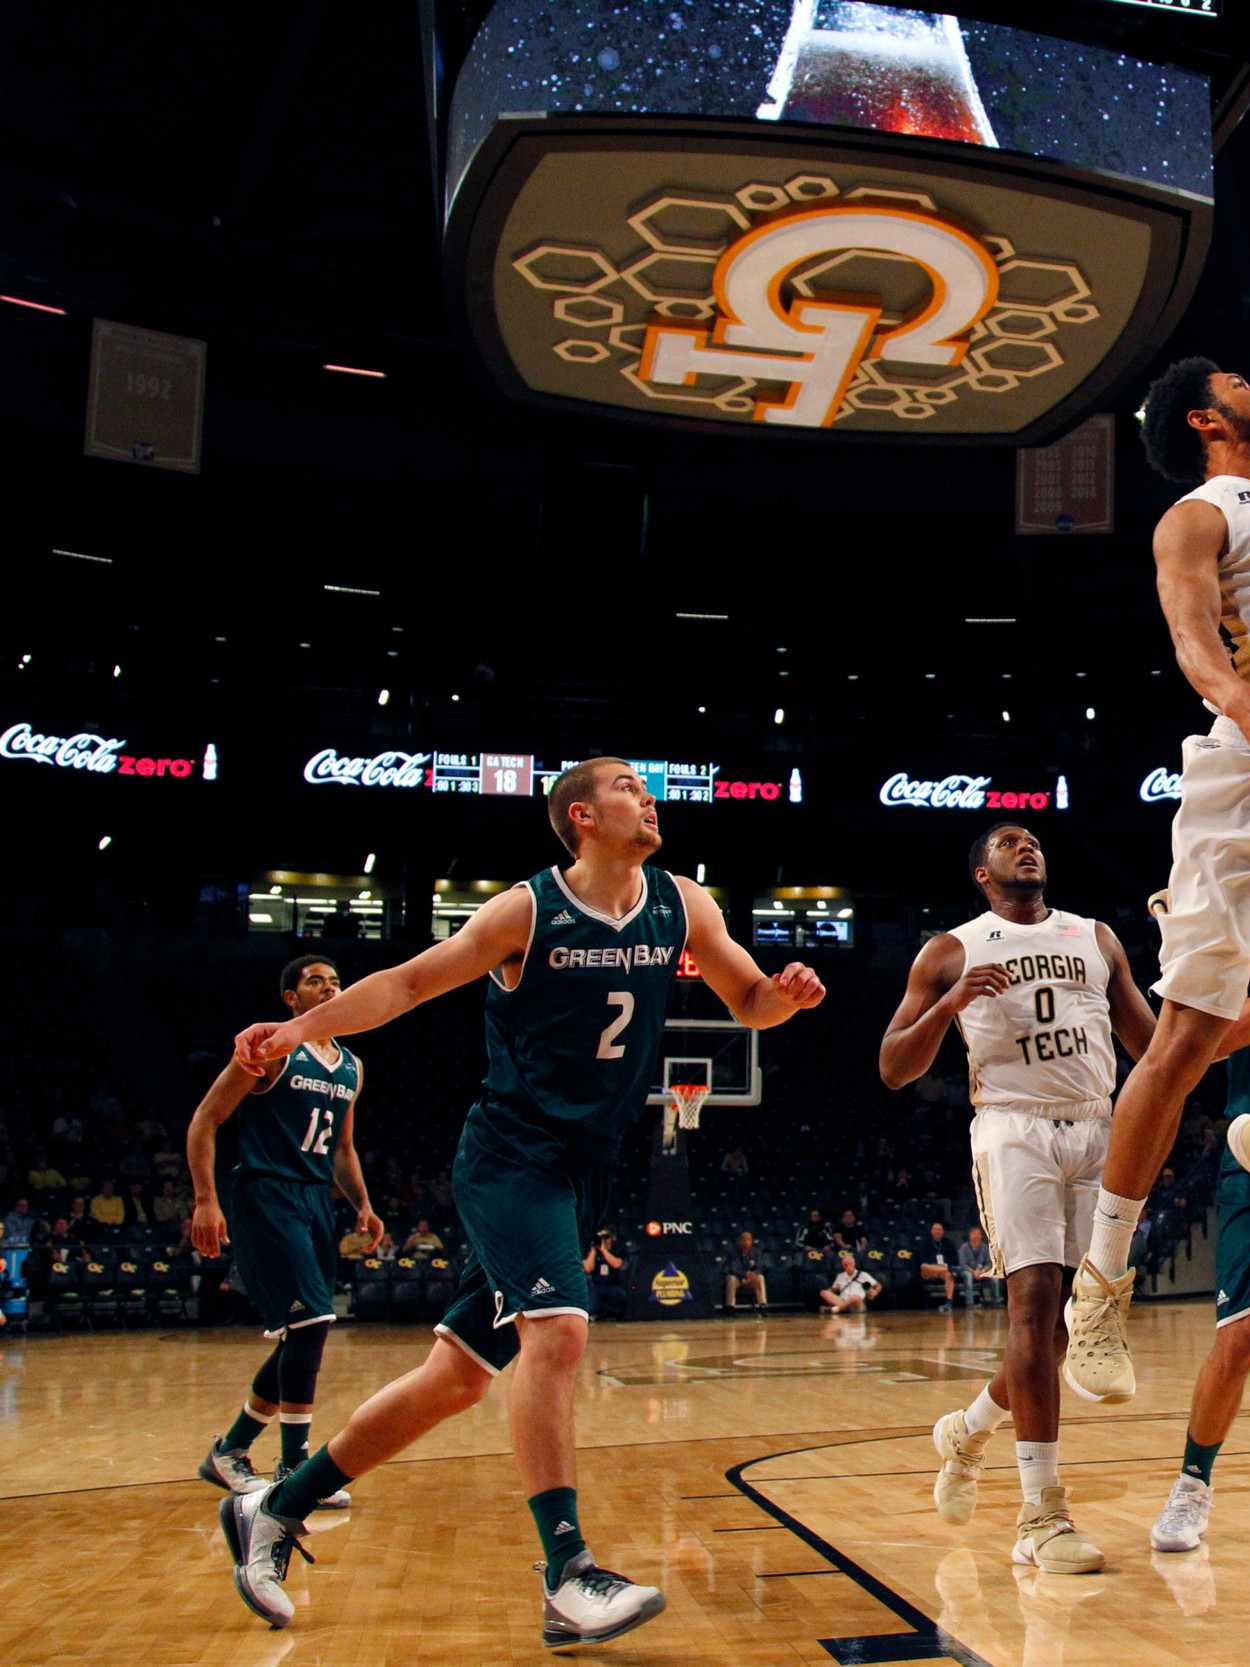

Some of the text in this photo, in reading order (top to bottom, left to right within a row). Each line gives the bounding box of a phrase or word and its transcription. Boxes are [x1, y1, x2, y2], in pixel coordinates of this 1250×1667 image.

[127, 372, 172, 401] 1992
[0, 723, 193, 778] Coca-Cola zero
[438, 754, 477, 766] FOULS 1
[486, 755, 524, 769] GA TECH
[303, 748, 432, 787] Coca-Cola
[494, 769, 517, 793] 18
[669, 763, 707, 775] FOULS 2
[714, 781, 780, 800] zero
[879, 772, 1049, 810] Coca-Cola zero
[549, 946, 632, 975] GREEN
[633, 944, 675, 966] BAY
[1003, 954, 1086, 985] EORGIA
[1035, 986, 1056, 1025] 0
[596, 991, 635, 1060] 2
[1016, 1026, 1089, 1066] TECH
[290, 1074, 356, 1102] GREEN BAY
[301, 1107, 334, 1155] 12
[662, 1221, 693, 1234] PNC
[531, 1286, 556, 1297] adidas
